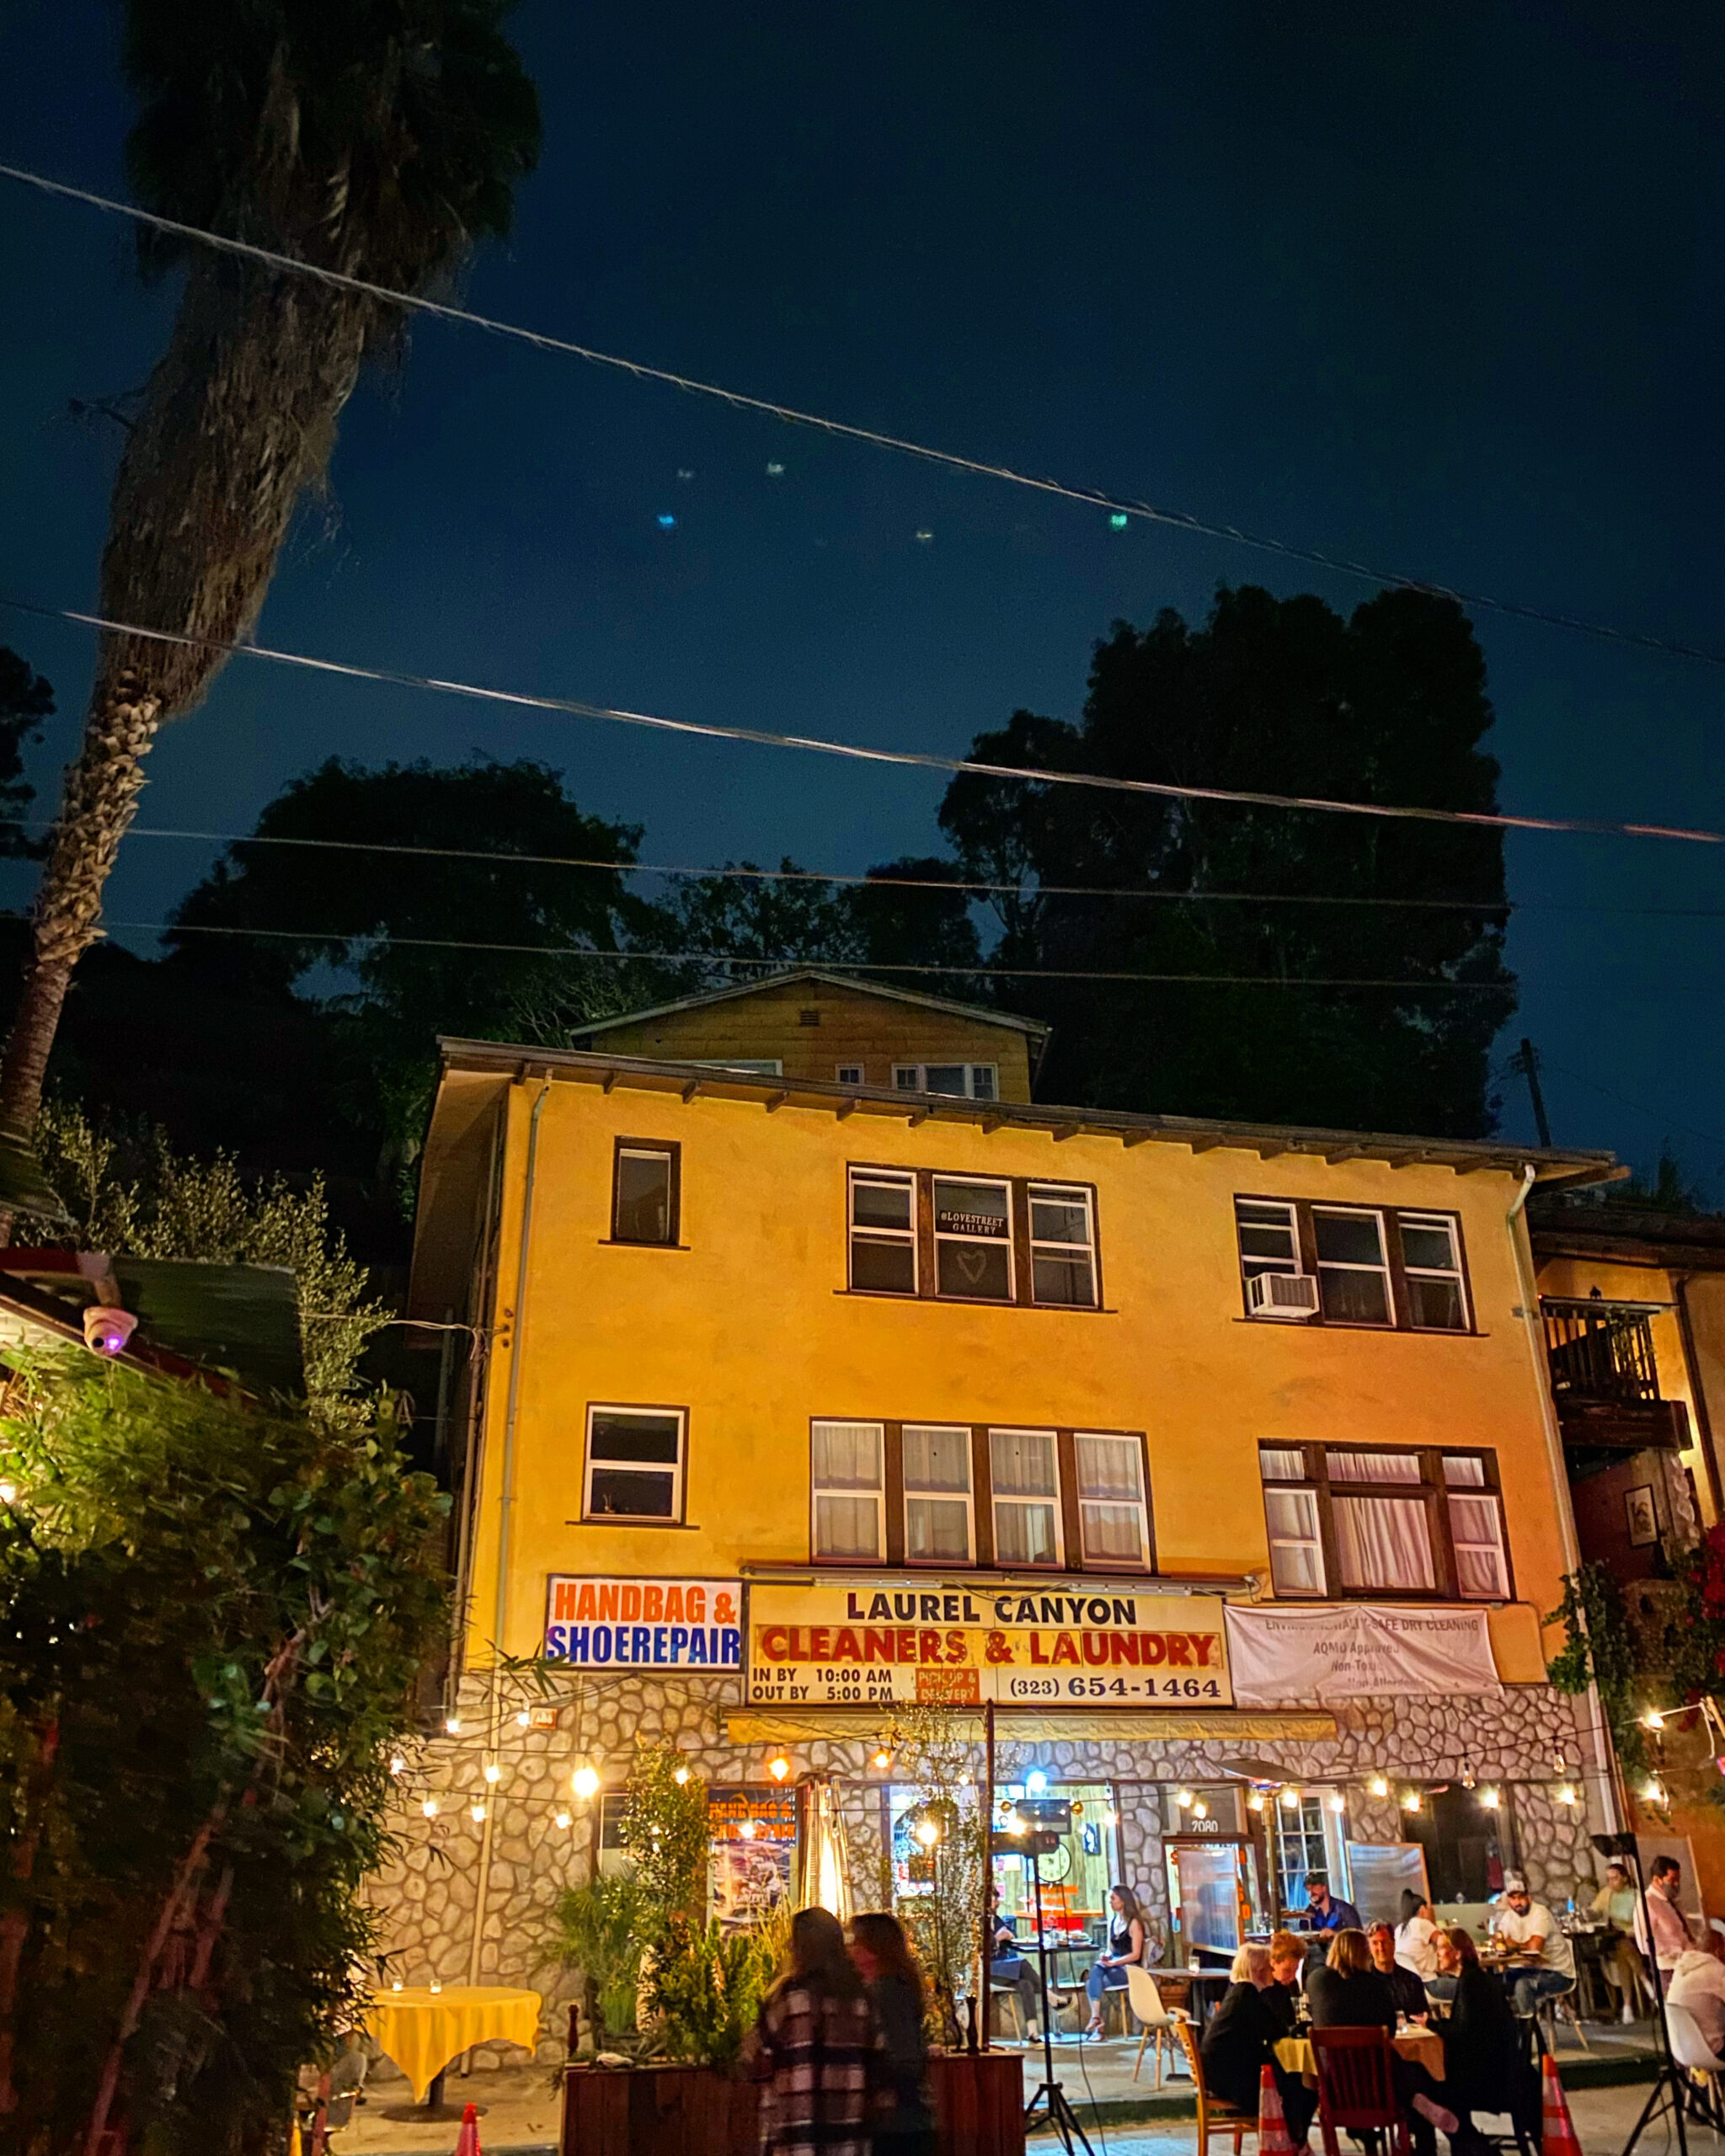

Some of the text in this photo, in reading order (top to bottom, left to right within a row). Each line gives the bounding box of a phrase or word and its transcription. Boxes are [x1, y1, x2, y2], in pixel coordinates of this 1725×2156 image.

[941, 1212, 1003, 1227] @LOVESTREET
[953, 1223, 996, 1235] GALLERY
[555, 1583, 736, 1624] HANDBAG &
[847, 1593, 1136, 1625] LAUREL CANYON
[1402, 1619, 1423, 1630] DRY
[1426, 1619, 1478, 1631] CLEANING
[547, 1625, 740, 1664] SHOEREPAIR
[762, 1627, 1215, 1666] CLEANERS & LAUNDRY
[1313, 1641, 1347, 1656] AQMD
[753, 1668, 892, 1683] IN BY 10:00 AM
[752, 1686, 893, 1700] OUT BY 5:00 PM
[921, 1687, 975, 1700] DEVERY
[1011, 1677, 1221, 1697] (323) 654-1464
